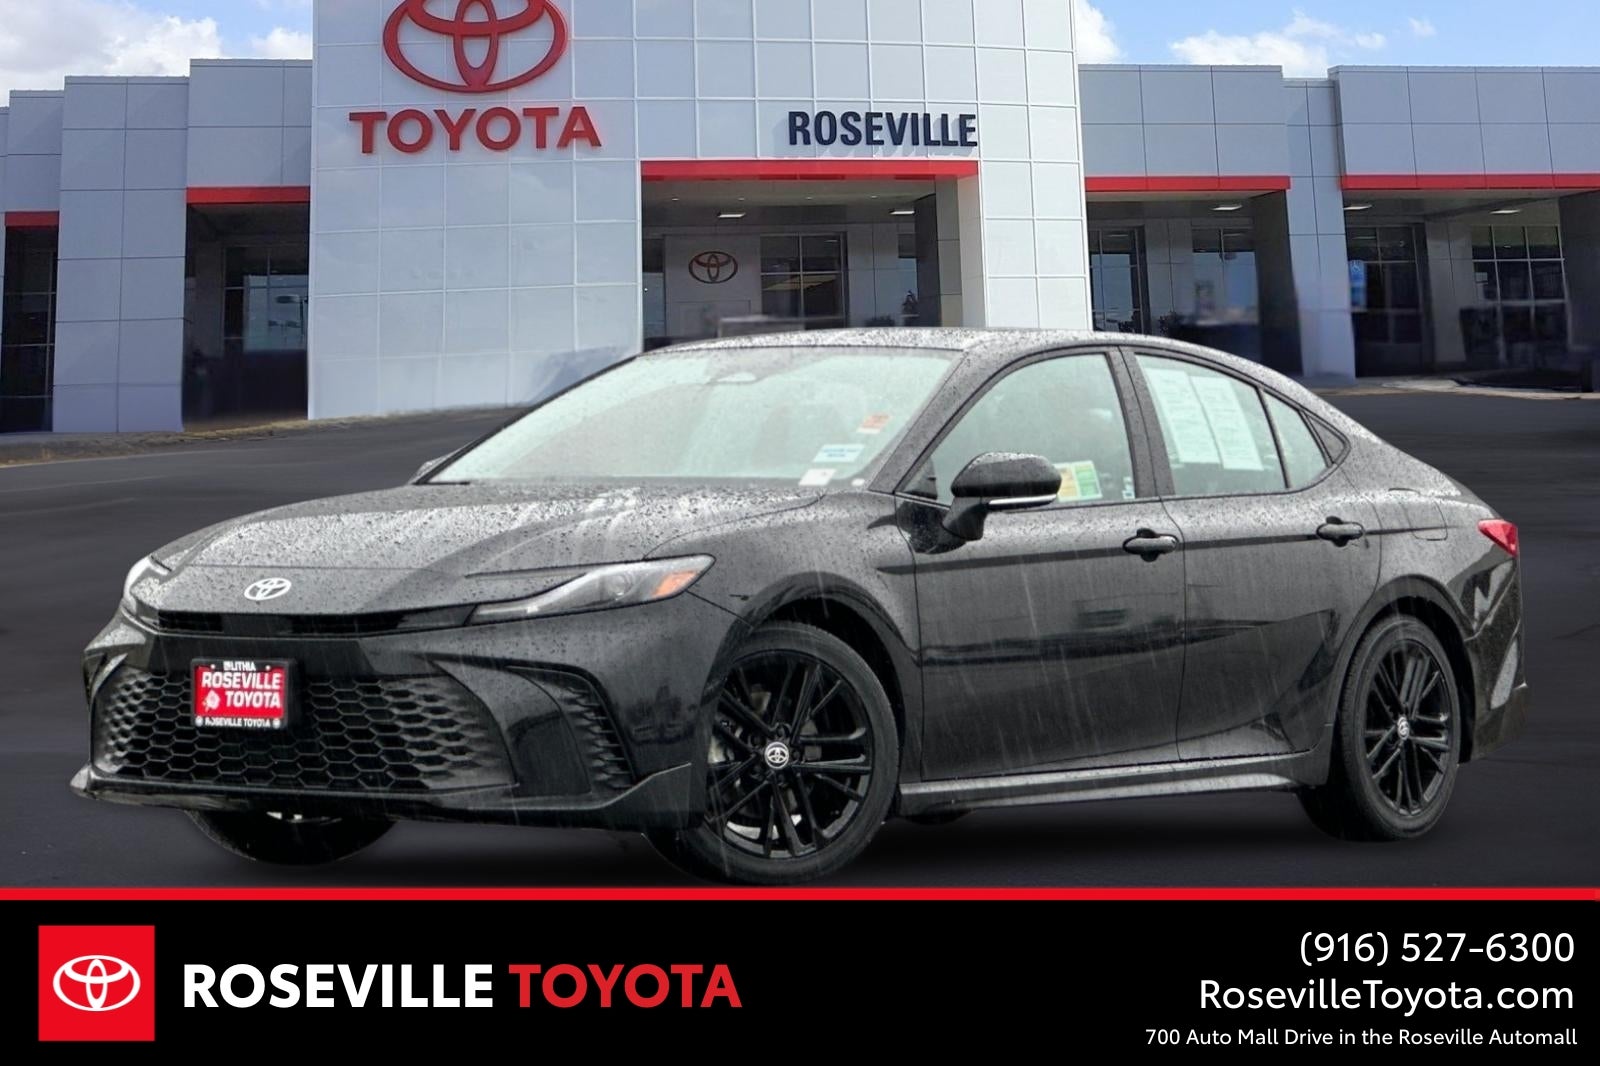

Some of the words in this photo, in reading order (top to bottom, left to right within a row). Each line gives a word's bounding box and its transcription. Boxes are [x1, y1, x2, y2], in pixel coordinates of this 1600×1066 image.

[349, 106, 603, 154] TOYOTA
[788, 110, 978, 147] ROSEVILLE
[201, 672, 281, 689] ROSEVILLE
[225, 691, 282, 708] TOYOTA
[205, 717, 242, 726] ROSEVILLE
[243, 718, 271, 728] TOYOTA
